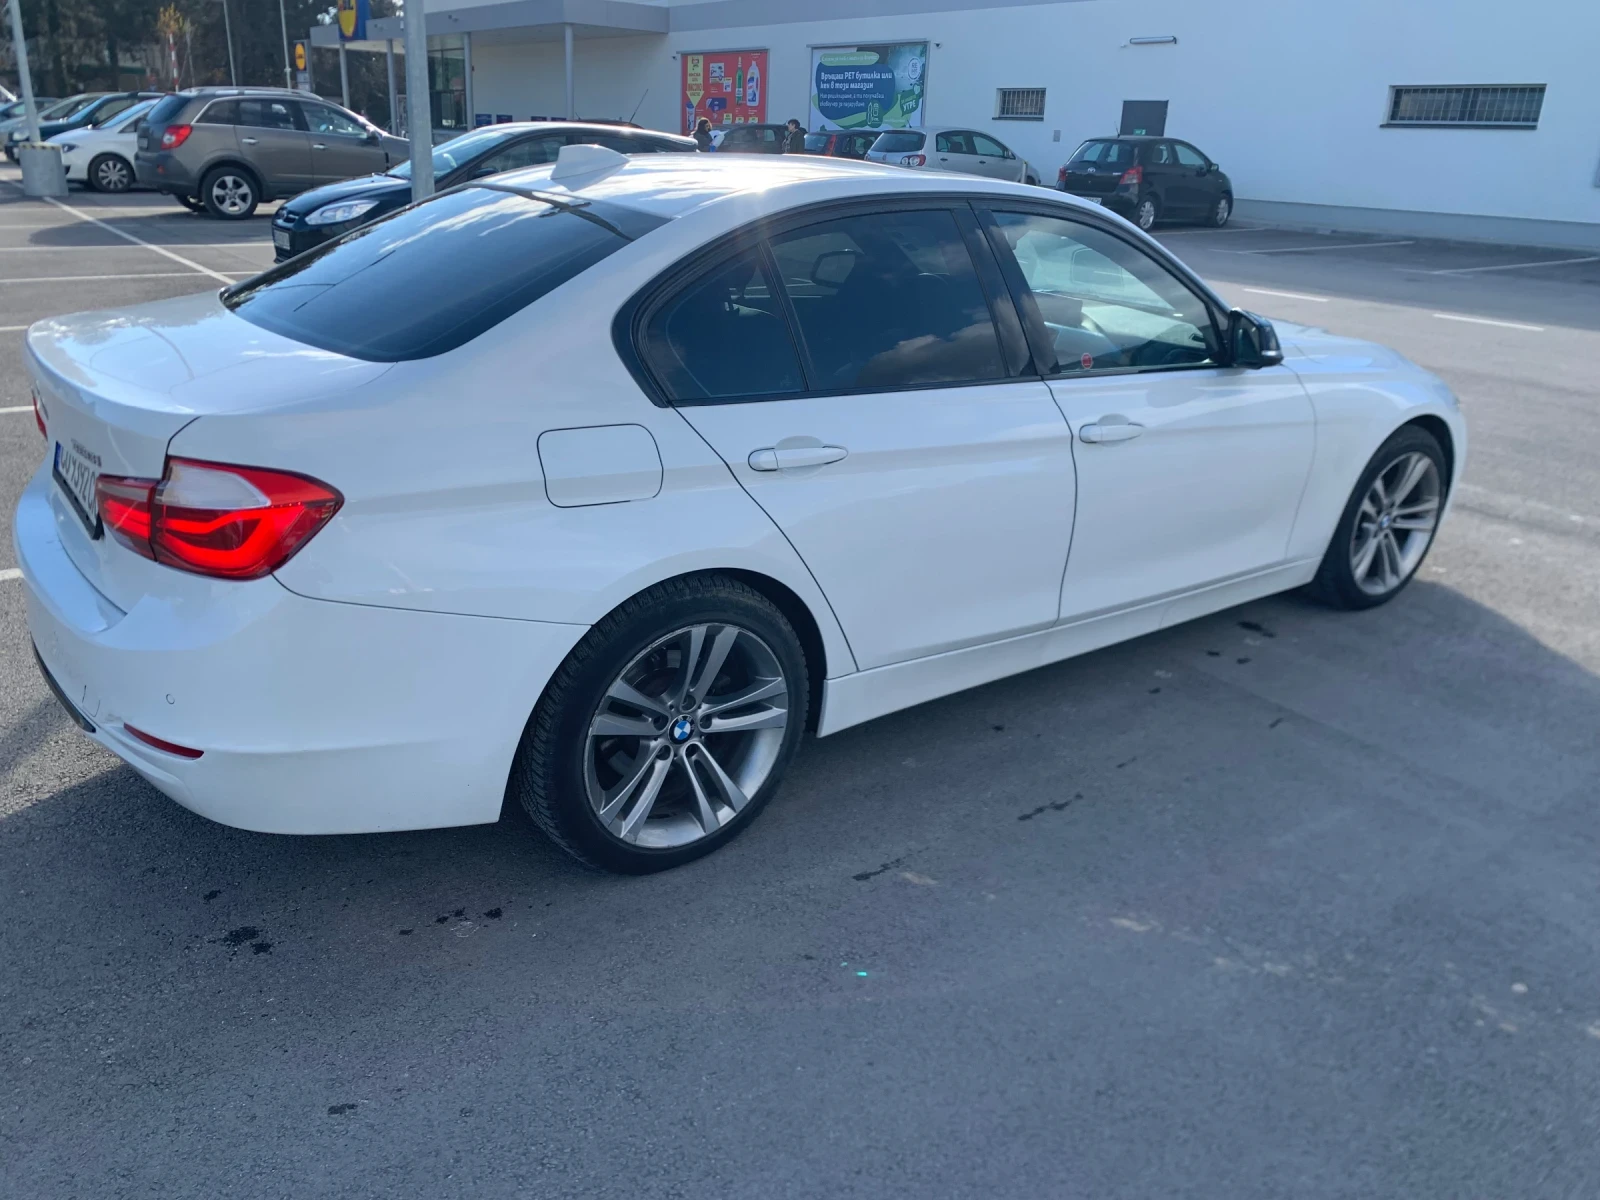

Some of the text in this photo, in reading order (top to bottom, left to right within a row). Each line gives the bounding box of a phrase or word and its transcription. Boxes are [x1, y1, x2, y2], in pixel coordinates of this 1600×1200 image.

[821, 72, 844, 81] Връщаш
[856, 71, 880, 80] бутилка
[830, 81, 834, 89] в
[835, 82, 849, 90] този
[850, 82, 874, 90] магазин
[902, 99, 916, 111] УТРЕ
